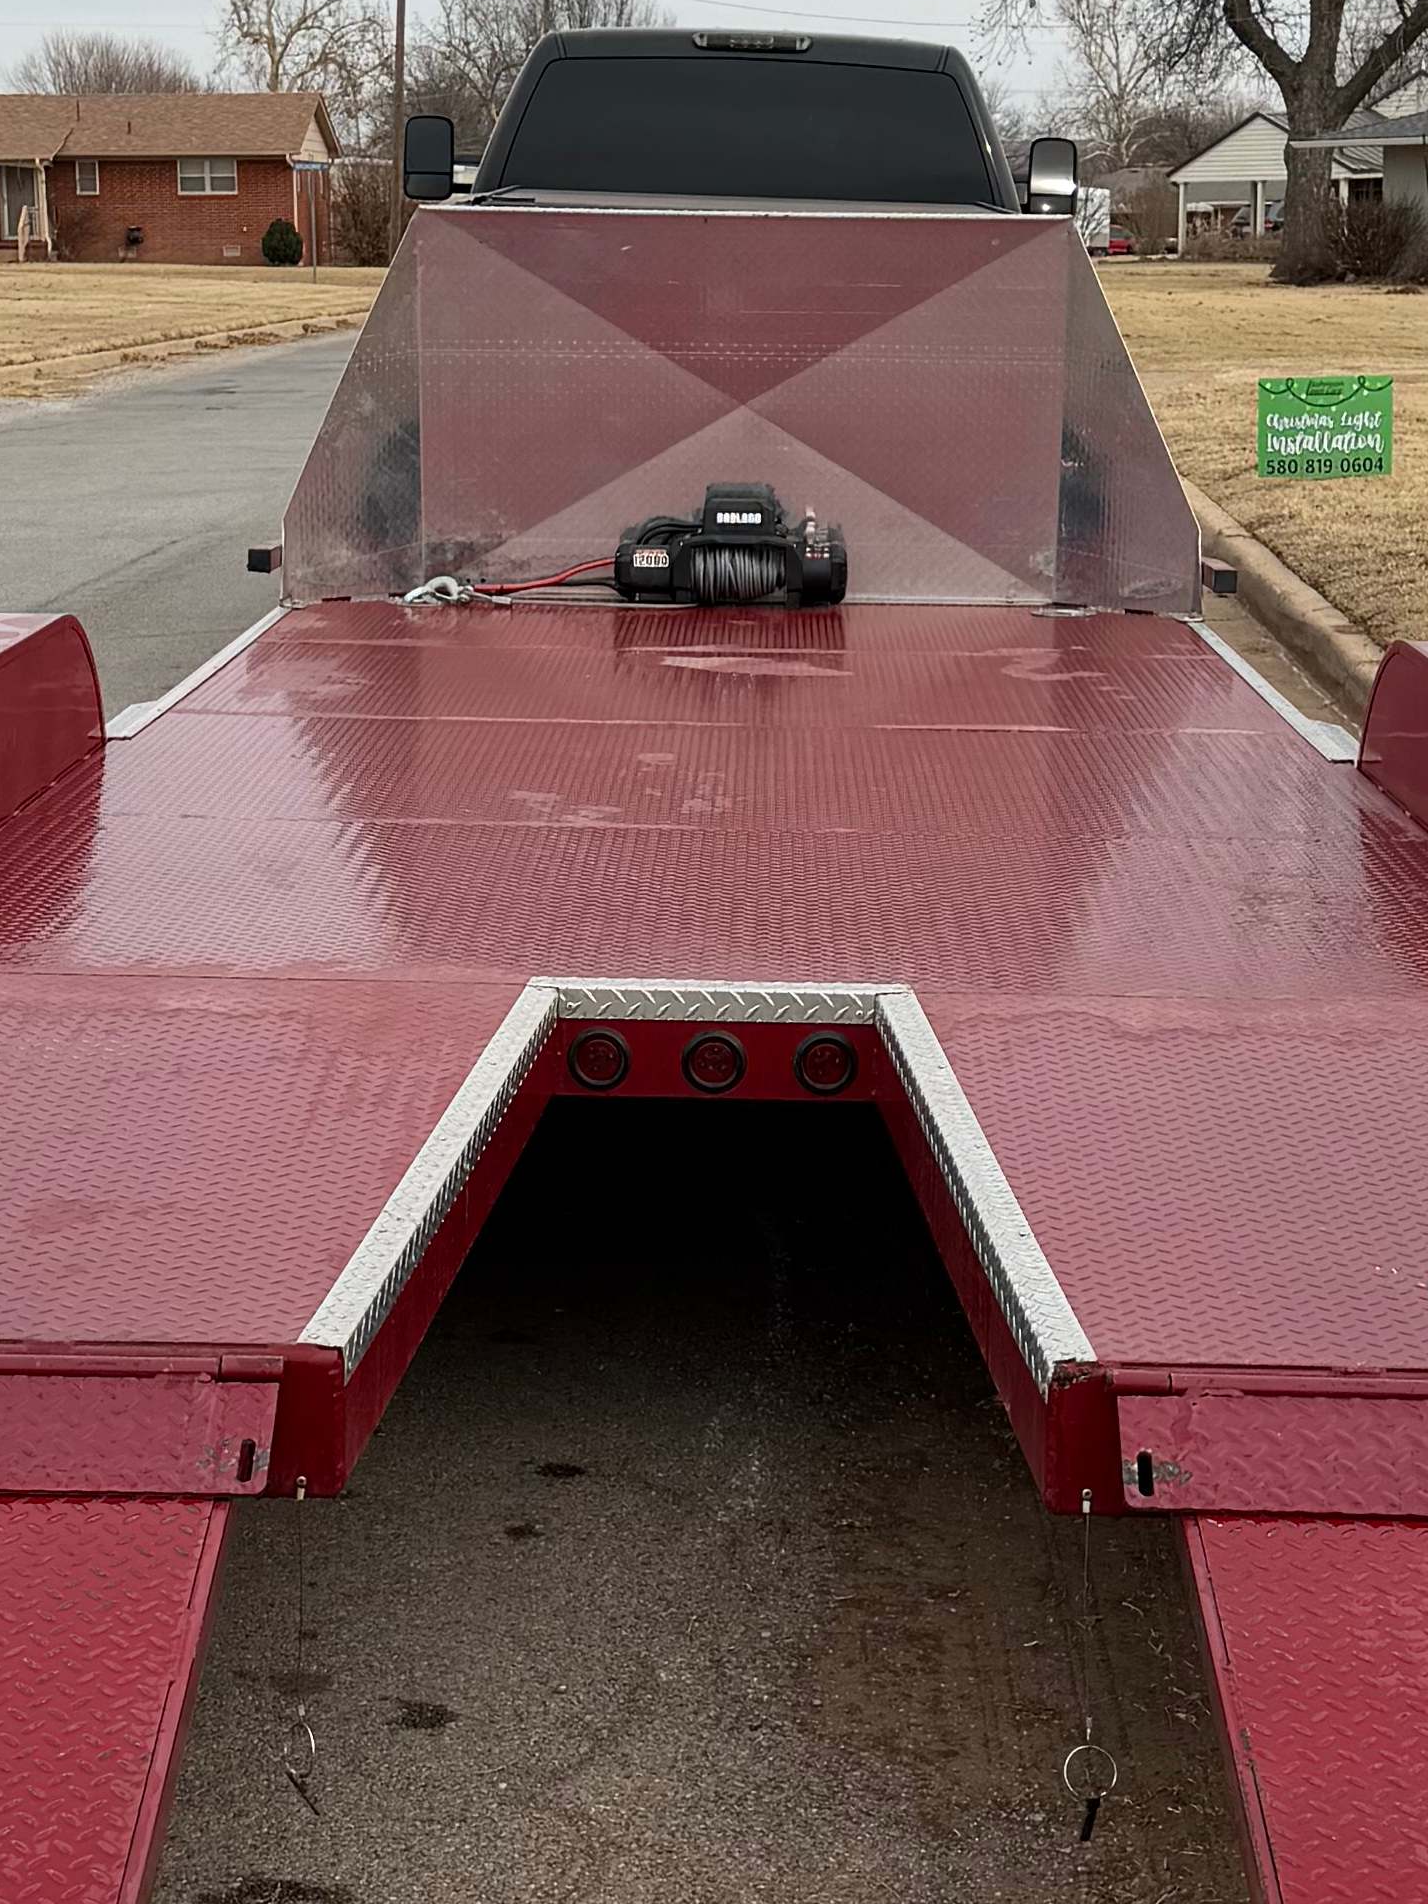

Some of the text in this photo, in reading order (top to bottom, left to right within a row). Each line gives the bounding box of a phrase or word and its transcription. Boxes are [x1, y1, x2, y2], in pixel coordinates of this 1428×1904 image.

[1266, 411, 1383, 432] Christmas Light
[1267, 431, 1385, 455] Installation
[1266, 456, 1384, 475] 580 819 0604
